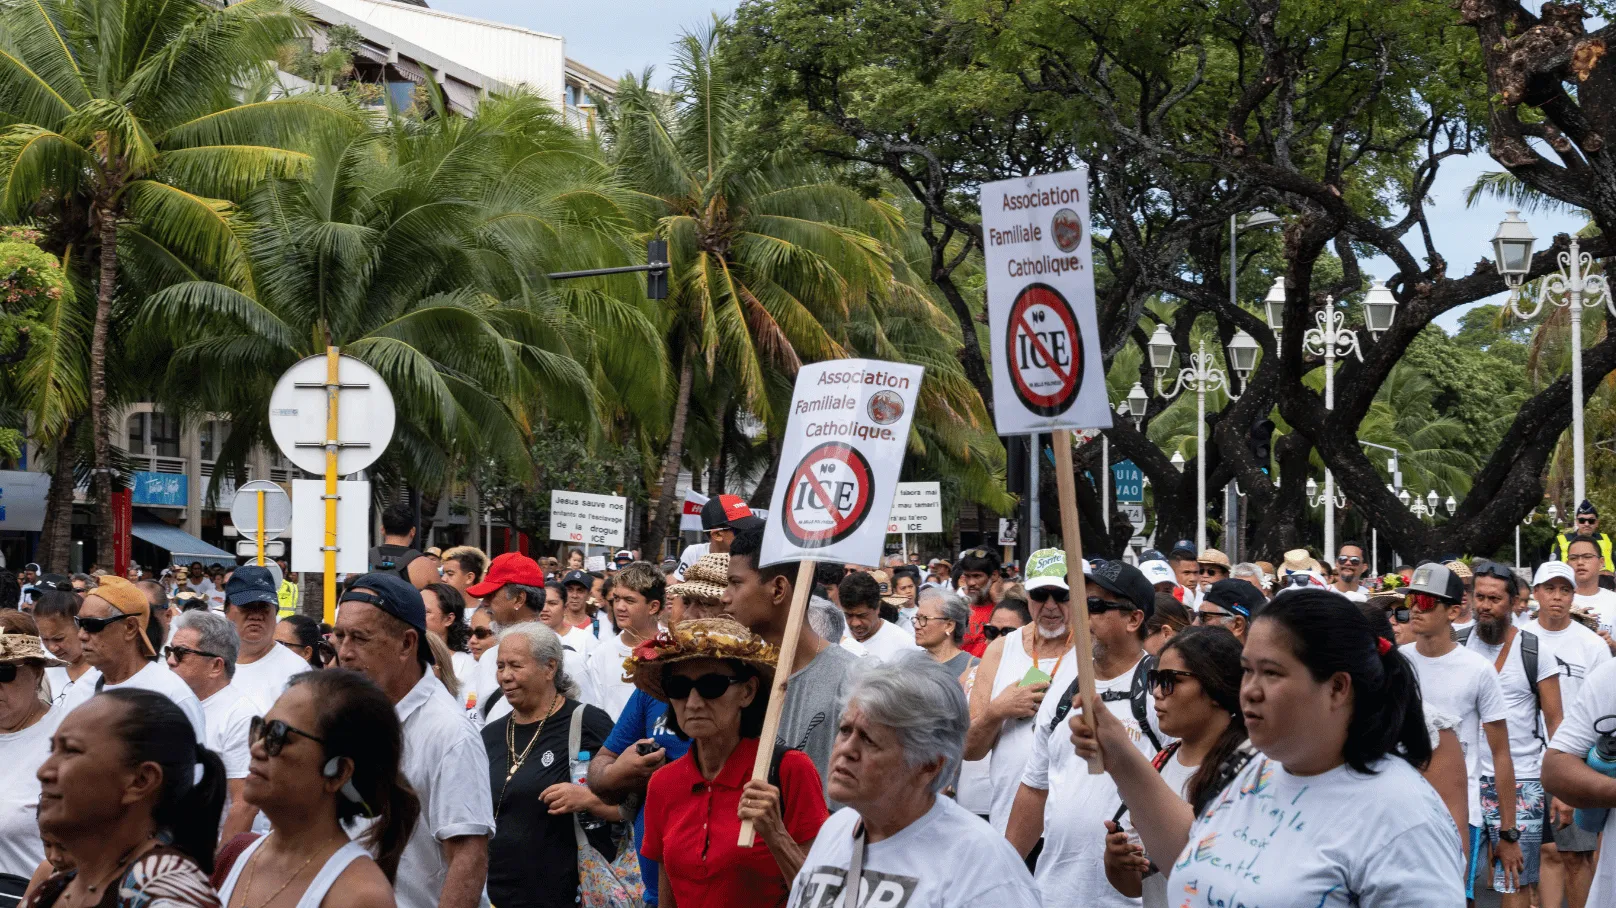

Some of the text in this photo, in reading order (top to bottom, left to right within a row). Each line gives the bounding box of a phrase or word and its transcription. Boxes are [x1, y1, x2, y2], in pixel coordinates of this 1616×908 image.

[1002, 187, 1080, 211] Association
[989, 223, 1042, 246] Familiale
[1008, 255, 1084, 277] Catholique.
[1031, 310, 1046, 323] NO
[1018, 330, 1070, 370] ICE
[817, 369, 910, 389] Association
[795, 394, 856, 415] Familiale
[805, 420, 896, 441] Catholique.
[820, 463, 836, 475] NO
[555, 497, 624, 511] Jesus sauve nos
[793, 480, 855, 512] ICE
[552, 510, 576, 518] enfants
[556, 521, 619, 535] de la drogue
[907, 523, 922, 531] ICE
[570, 533, 605, 543] NO ICE
[1037, 553, 1063, 569] Sprite
